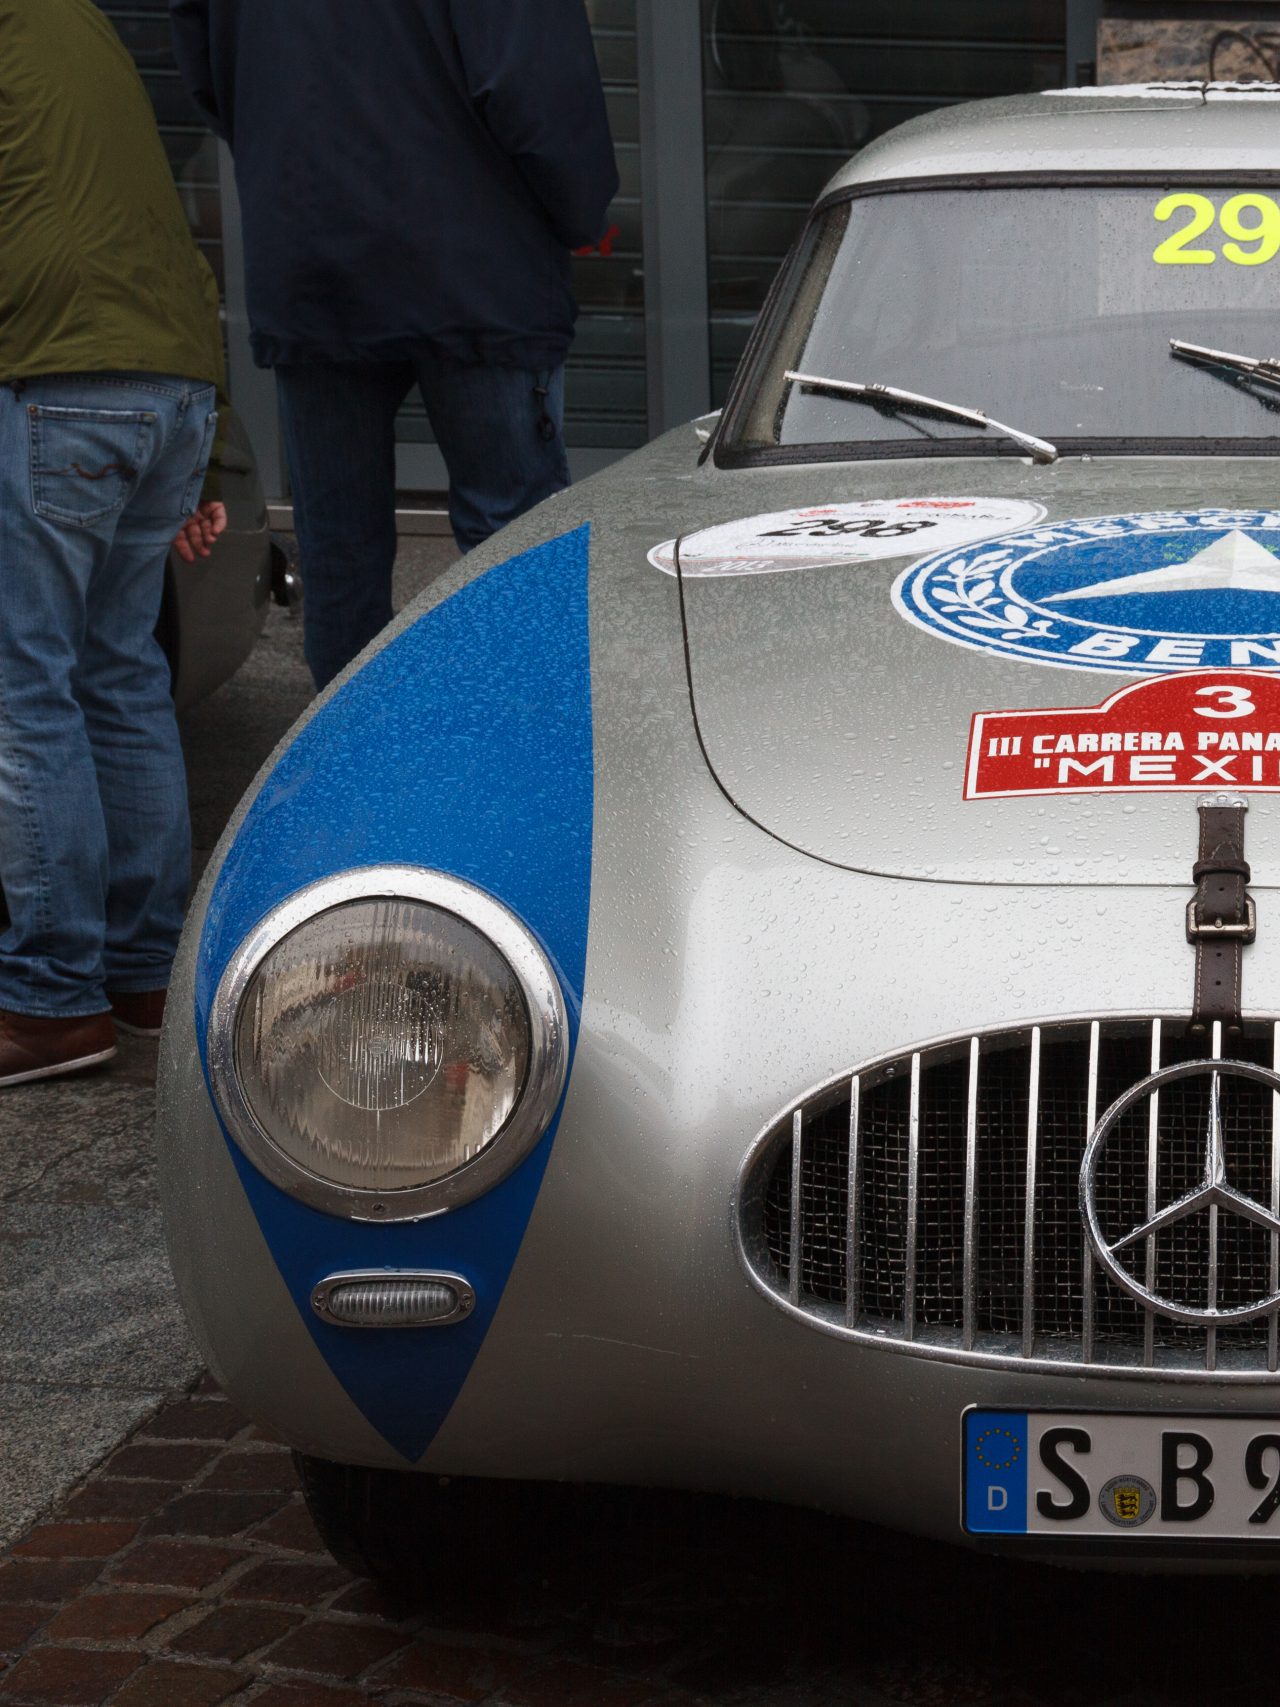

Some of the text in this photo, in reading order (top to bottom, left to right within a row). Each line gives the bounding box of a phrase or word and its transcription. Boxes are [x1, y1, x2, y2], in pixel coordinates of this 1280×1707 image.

[757, 519, 938, 538] 298
[701, 560, 776, 573] 2013
[1192, 684, 1257, 719] 3
[987, 735, 1022, 758] III
[1032, 732, 1184, 755] CARRERA
[1036, 1427, 1092, 1521] S
[1160, 1431, 1214, 1522] B
[988, 1485, 1008, 1511] D
